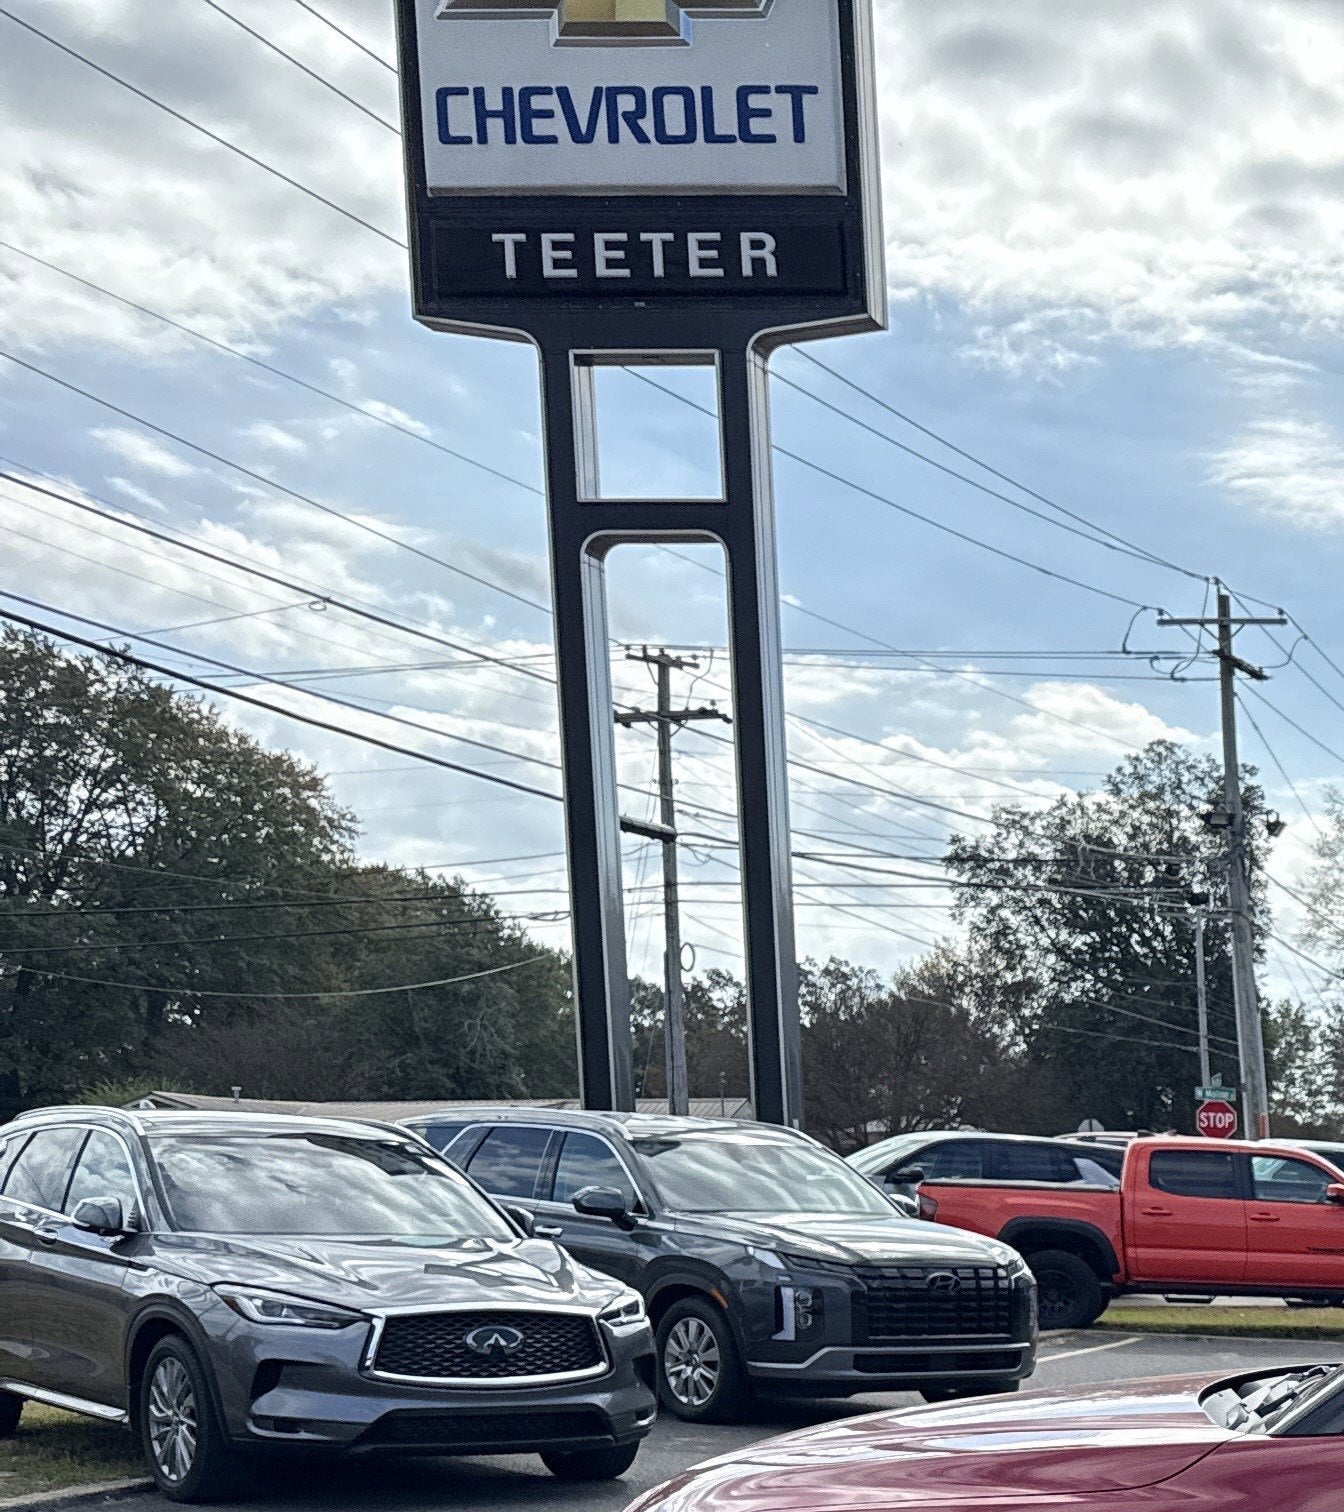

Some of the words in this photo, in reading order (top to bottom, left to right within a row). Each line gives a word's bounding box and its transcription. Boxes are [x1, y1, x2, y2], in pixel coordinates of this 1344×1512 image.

[435, 85, 819, 145] CHEVROLET
[491, 231, 778, 279] TEETER
[1199, 1111, 1234, 1129] STOP
